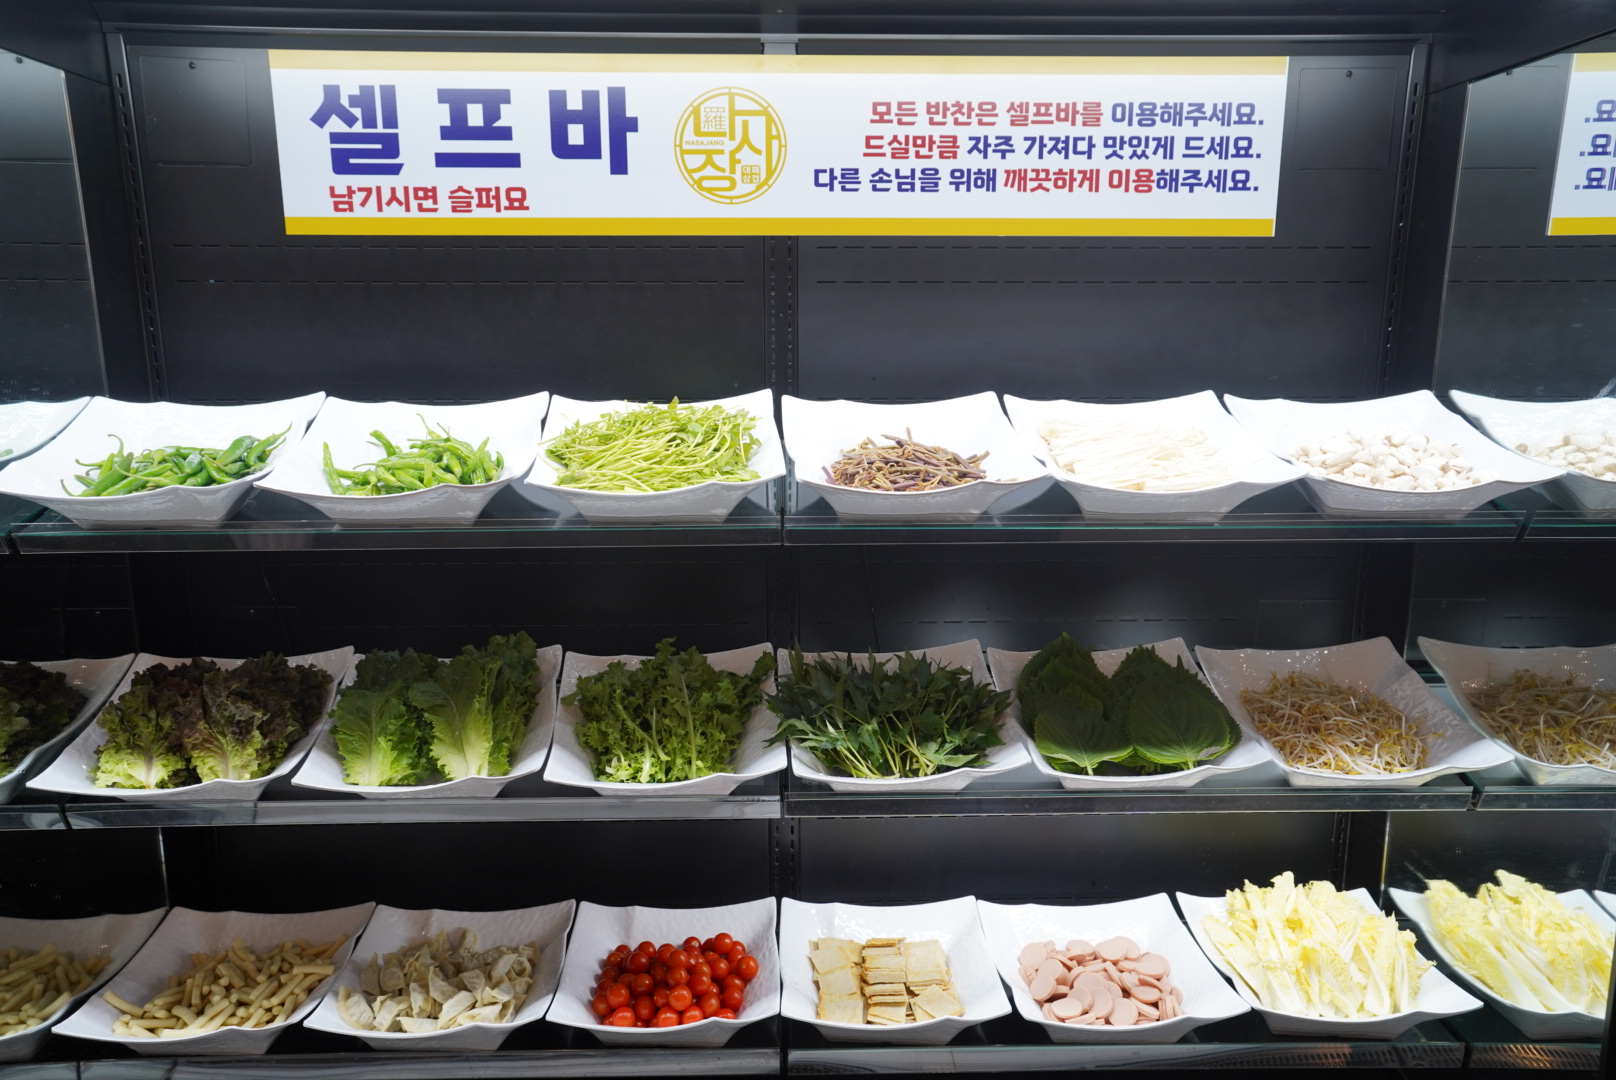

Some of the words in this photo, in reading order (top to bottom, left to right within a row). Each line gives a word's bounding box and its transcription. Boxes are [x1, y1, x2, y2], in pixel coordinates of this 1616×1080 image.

[870, 101, 918, 126] 모든
[926, 101, 999, 126] 반찬은
[1006, 102, 1103, 127] 셀프바를
[1111, 102, 1264, 127] 이용해주세요.
[684, 139, 726, 147] NASAJANG
[862, 134, 960, 160] 드실만큼
[966, 135, 1016, 160] 자주
[1023, 135, 1096, 160] 가져다
[1102, 136, 1175, 161] 맛있게
[1181, 136, 1262, 161] 드세요.
[813, 167, 862, 192] 다른
[869, 168, 942, 193] 손님을
[948, 168, 997, 193] 위해
[1003, 168, 1101, 193] 깨끗하게
[1108, 168, 1259, 194] 이용해주세요.
[329, 185, 439, 213] 남기시면
[447, 186, 530, 214] 슬퍼요
